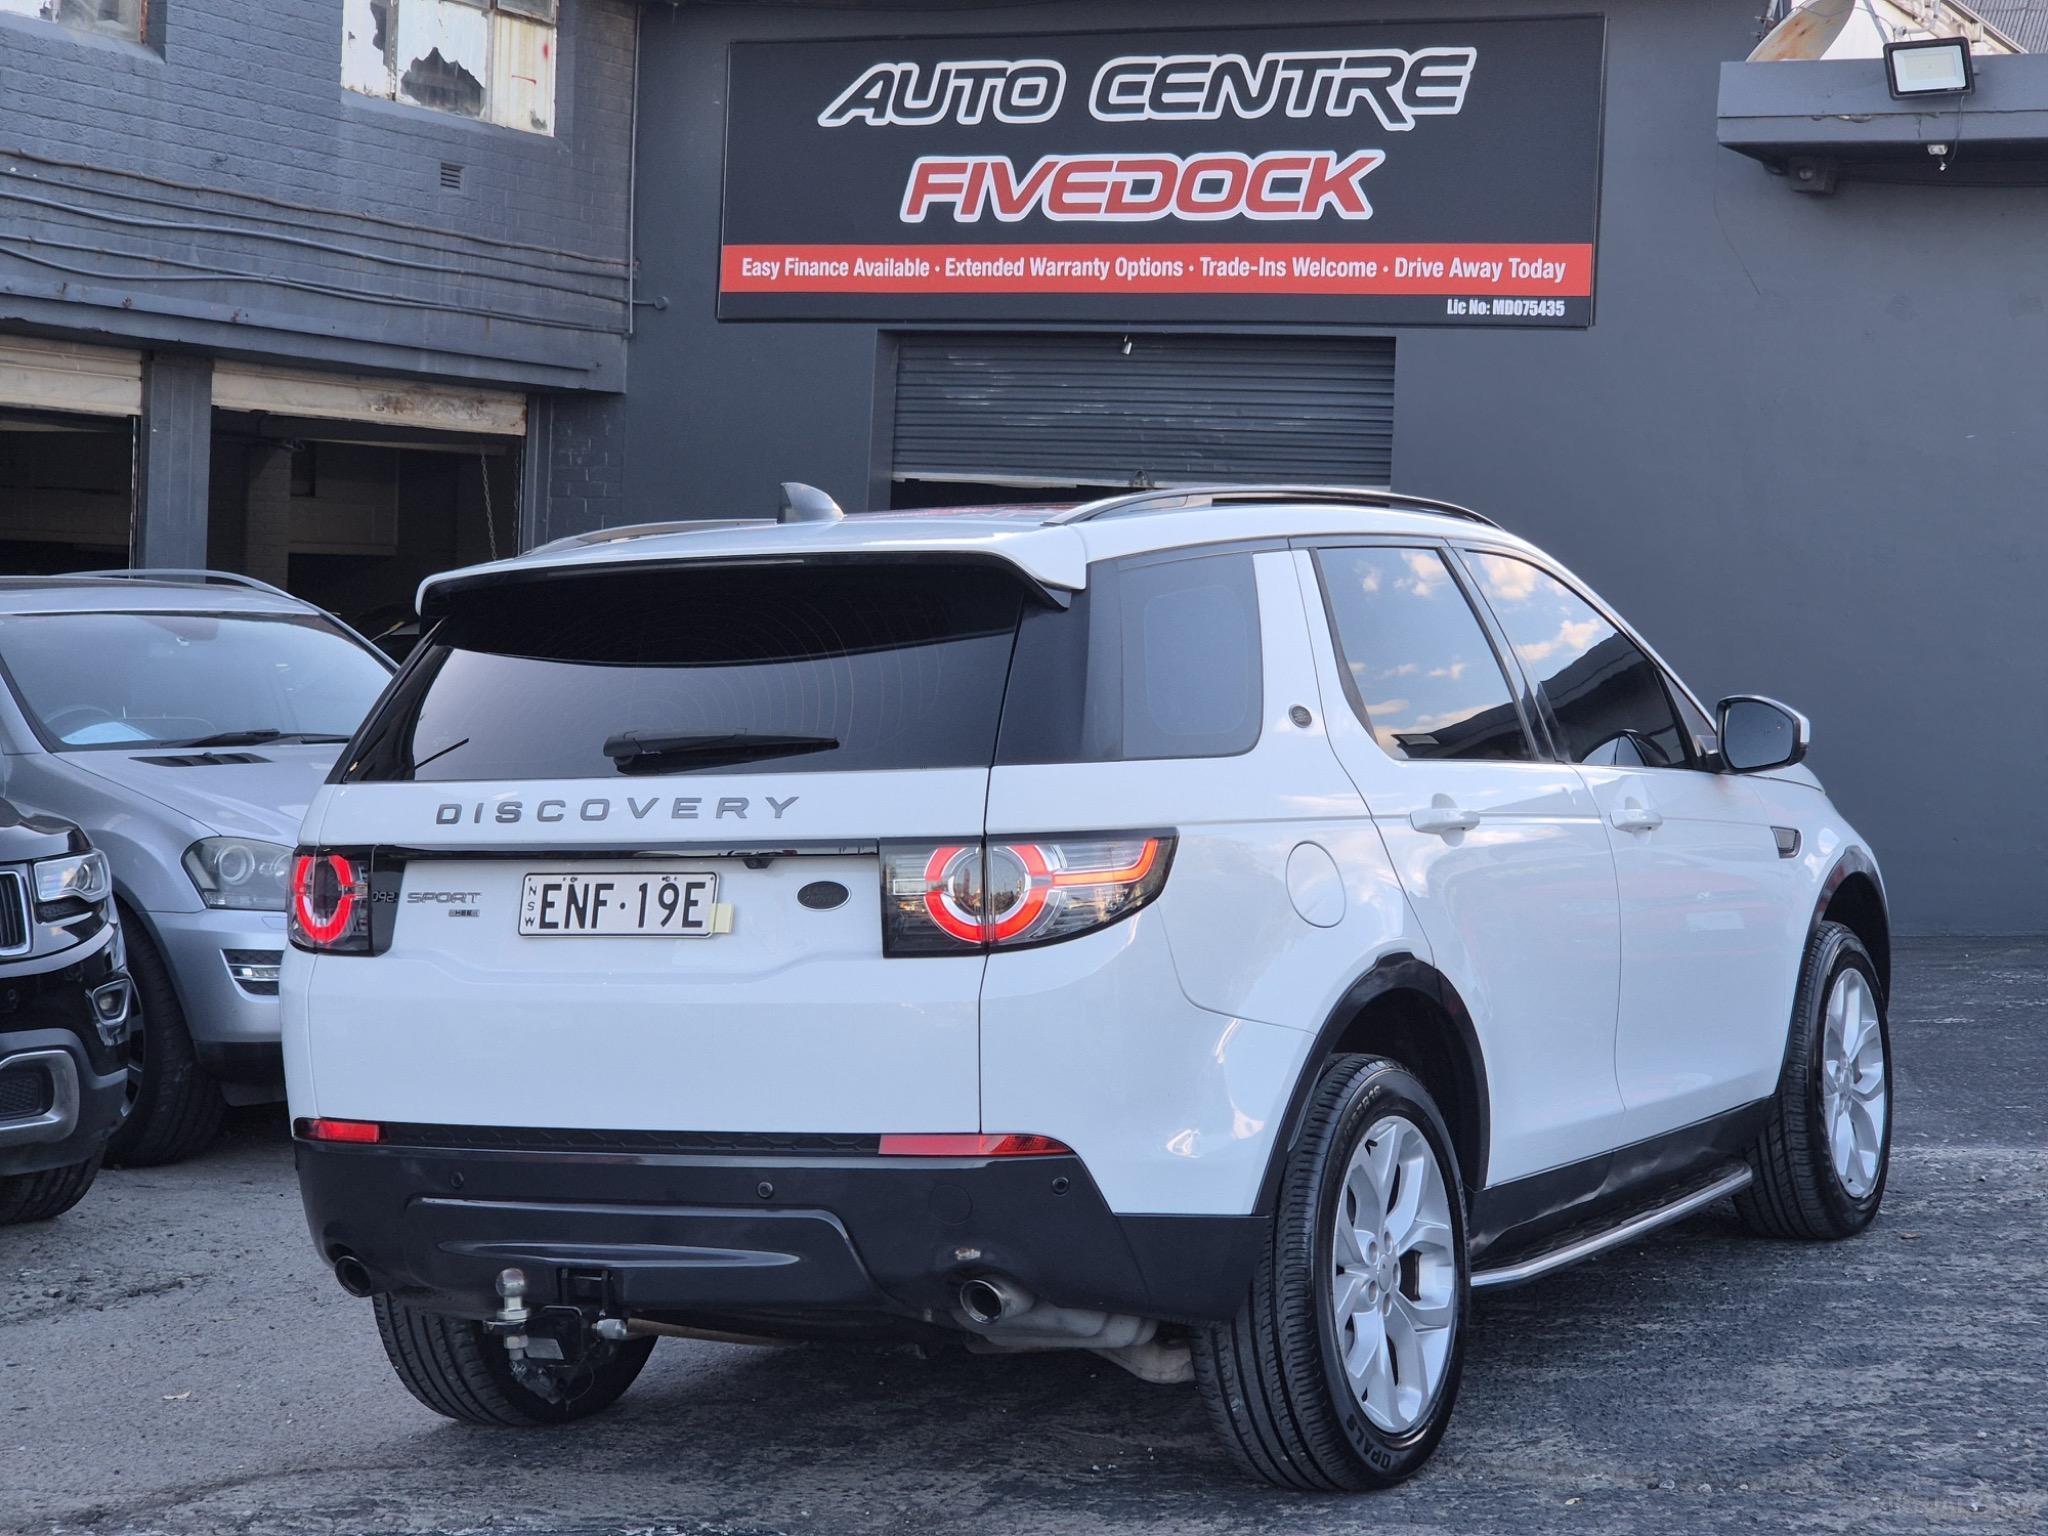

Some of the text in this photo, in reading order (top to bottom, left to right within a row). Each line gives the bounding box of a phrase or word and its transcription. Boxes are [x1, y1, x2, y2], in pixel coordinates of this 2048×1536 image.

[818, 47, 1477, 130] AUTO CENTRE
[899, 150, 1386, 222] FIVEDOCK
[742, 256, 1566, 283] Easy Finance Available Extended Warranty Options Trade-Ins Welcome Drive Away Today
[1447, 299, 1566, 317] Lic No: MD075435
[435, 796, 800, 825] DISCOVERY
[407, 891, 482, 904] SPORT
